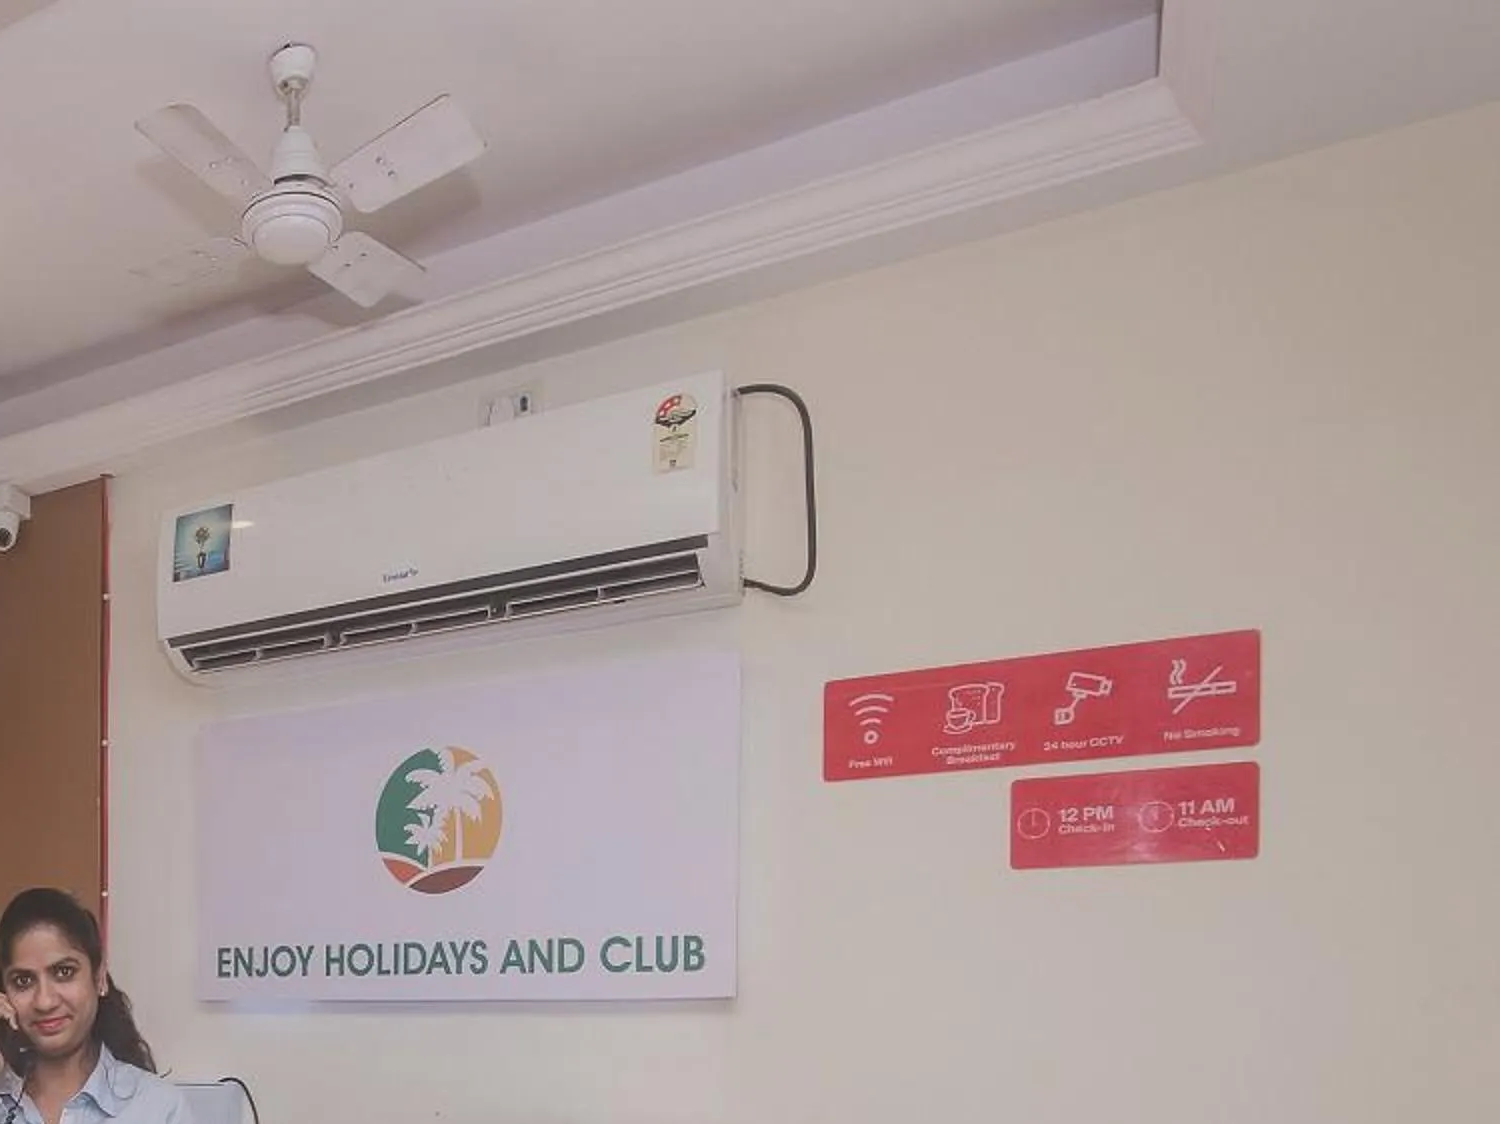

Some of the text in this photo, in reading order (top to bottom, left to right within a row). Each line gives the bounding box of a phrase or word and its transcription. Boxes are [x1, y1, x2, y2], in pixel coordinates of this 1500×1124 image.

[1183, 726, 1241, 741] Smoking
[1043, 735, 1125, 751] 24 hour CCTV
[848, 759, 872, 769] Free
[1058, 805, 1115, 823] 12 PM
[1178, 798, 1236, 816] 11 AM
[1058, 821, 1116, 835] Check-in
[1178, 815, 1249, 829] Check-out
[216, 934, 706, 978] ENJOY HOLIDAYS AND CLUB
